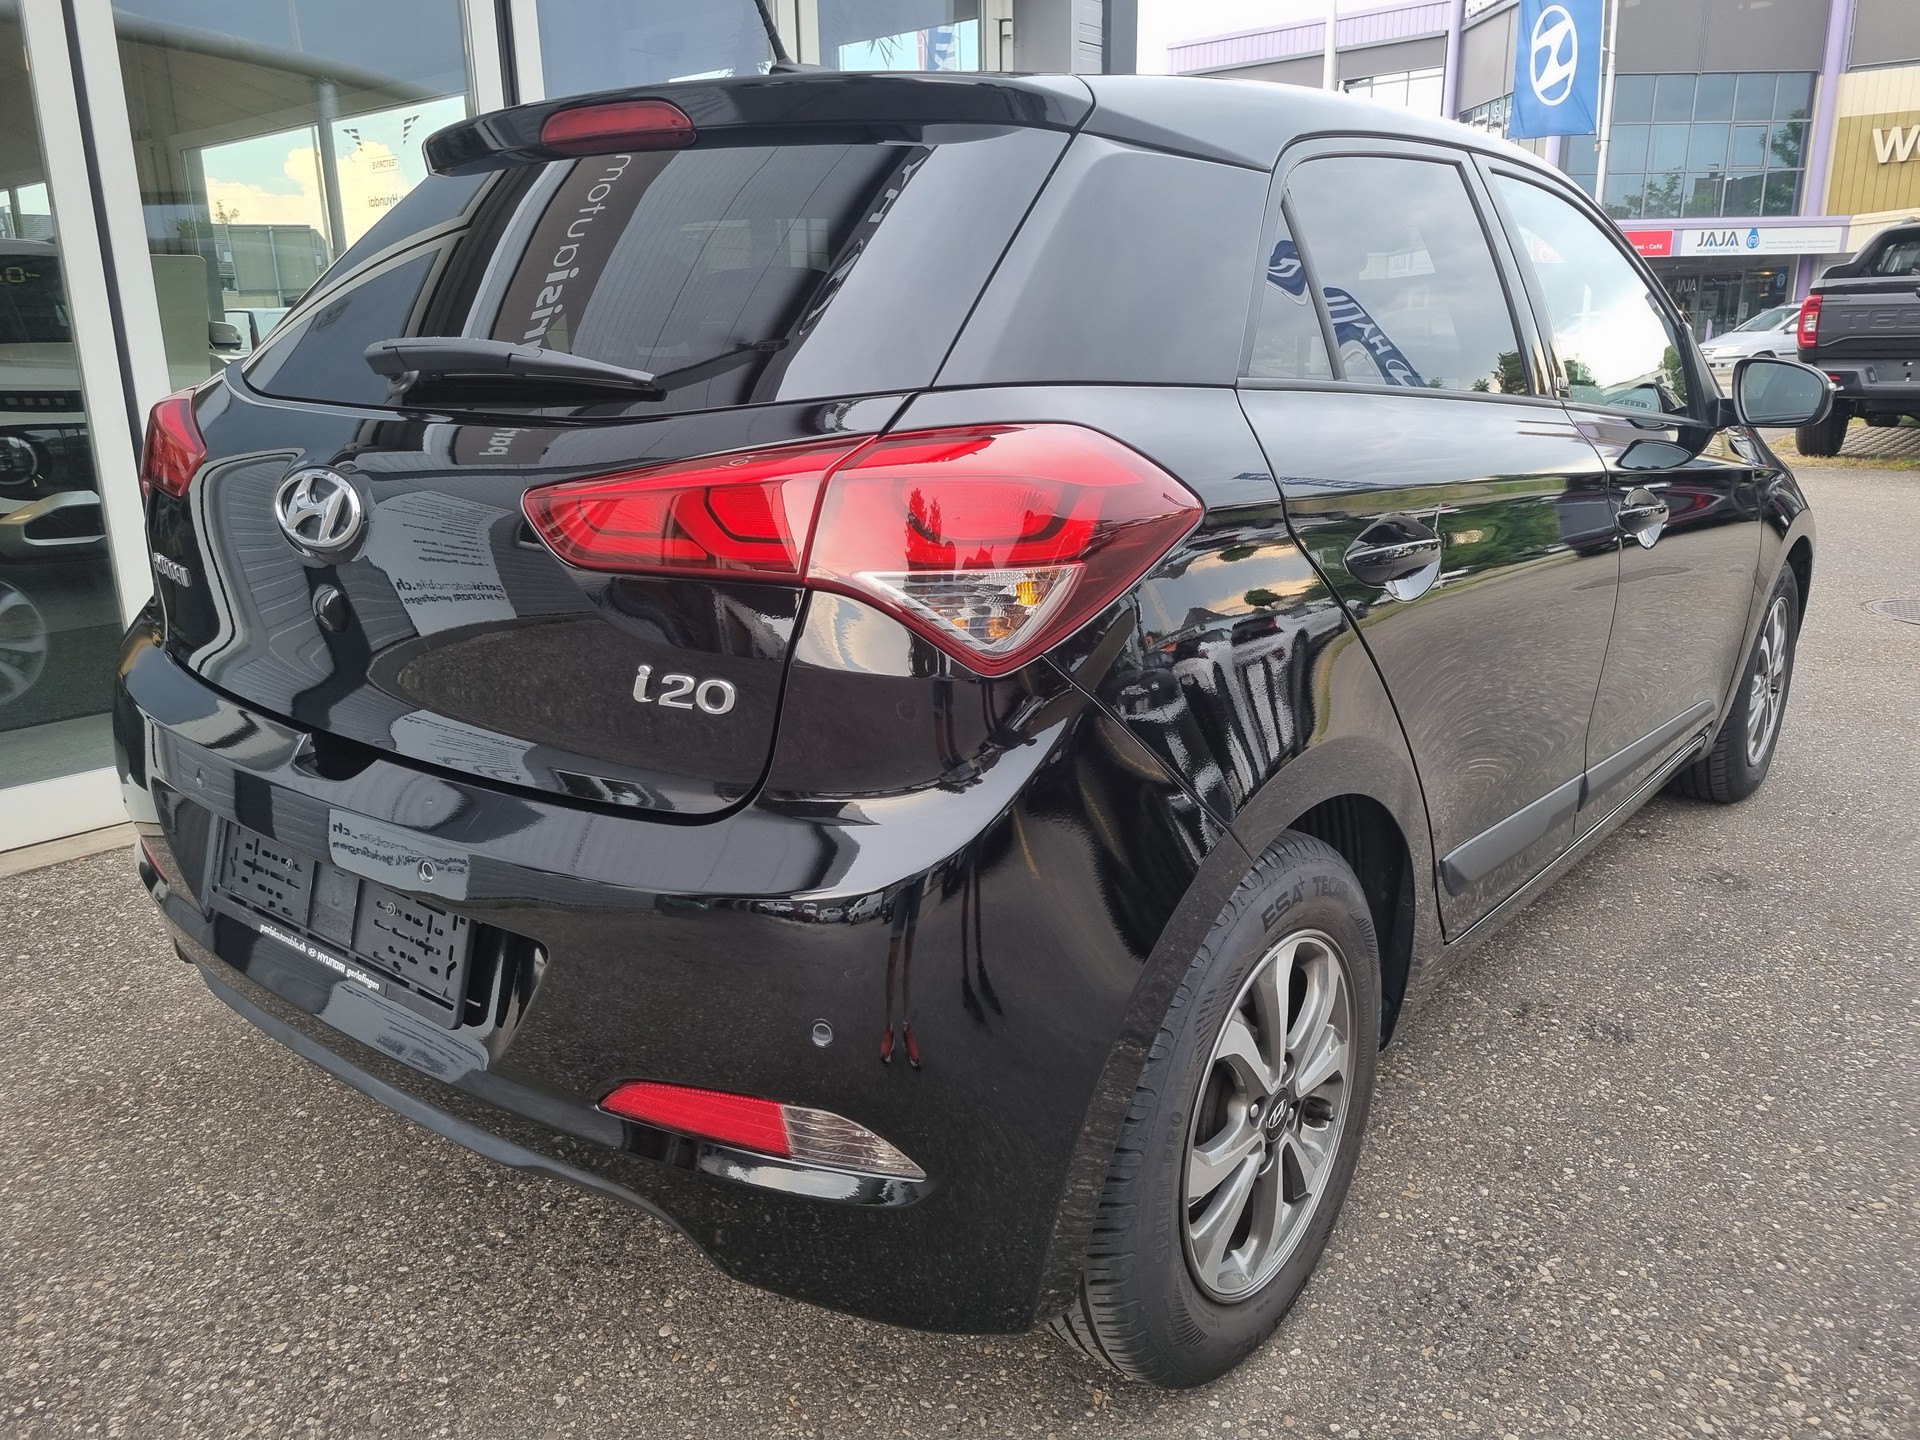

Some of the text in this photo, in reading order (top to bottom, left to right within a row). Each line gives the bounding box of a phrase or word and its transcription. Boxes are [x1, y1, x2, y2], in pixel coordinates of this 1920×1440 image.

[1697, 231, 1739, 247] JAJA
[633, 665, 736, 715] i20
[260, 924, 380, 991] parisiautomobile.ch HYUNDAI gerlafingen
